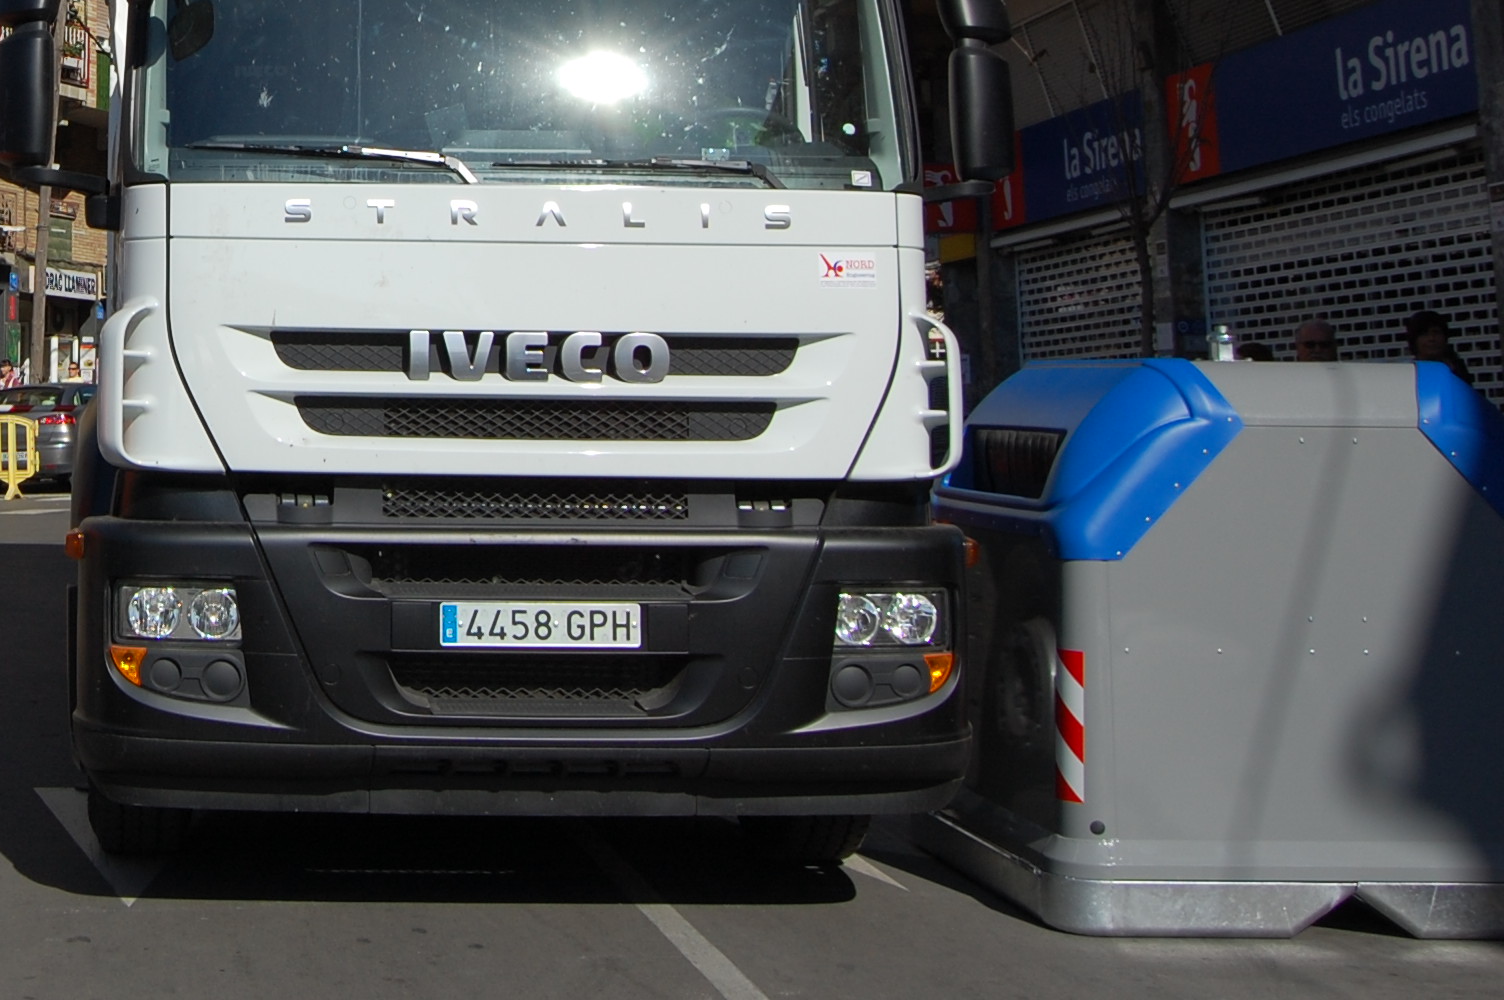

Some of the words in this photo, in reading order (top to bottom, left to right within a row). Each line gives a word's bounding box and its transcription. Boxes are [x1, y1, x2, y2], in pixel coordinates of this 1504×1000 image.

[1334, 46, 1364, 101] la
[1367, 23, 1470, 92] Sirena
[1341, 103, 1361, 129] els
[1363, 87, 1429, 124] congelats
[1063, 137, 1081, 180] la
[284, 198, 792, 230] STRALIS
[845, 259, 875, 270] NORD
[404, 329, 671, 384] IVECO
[465, 609, 553, 641] 4458
[566, 609, 632, 642] GPH
